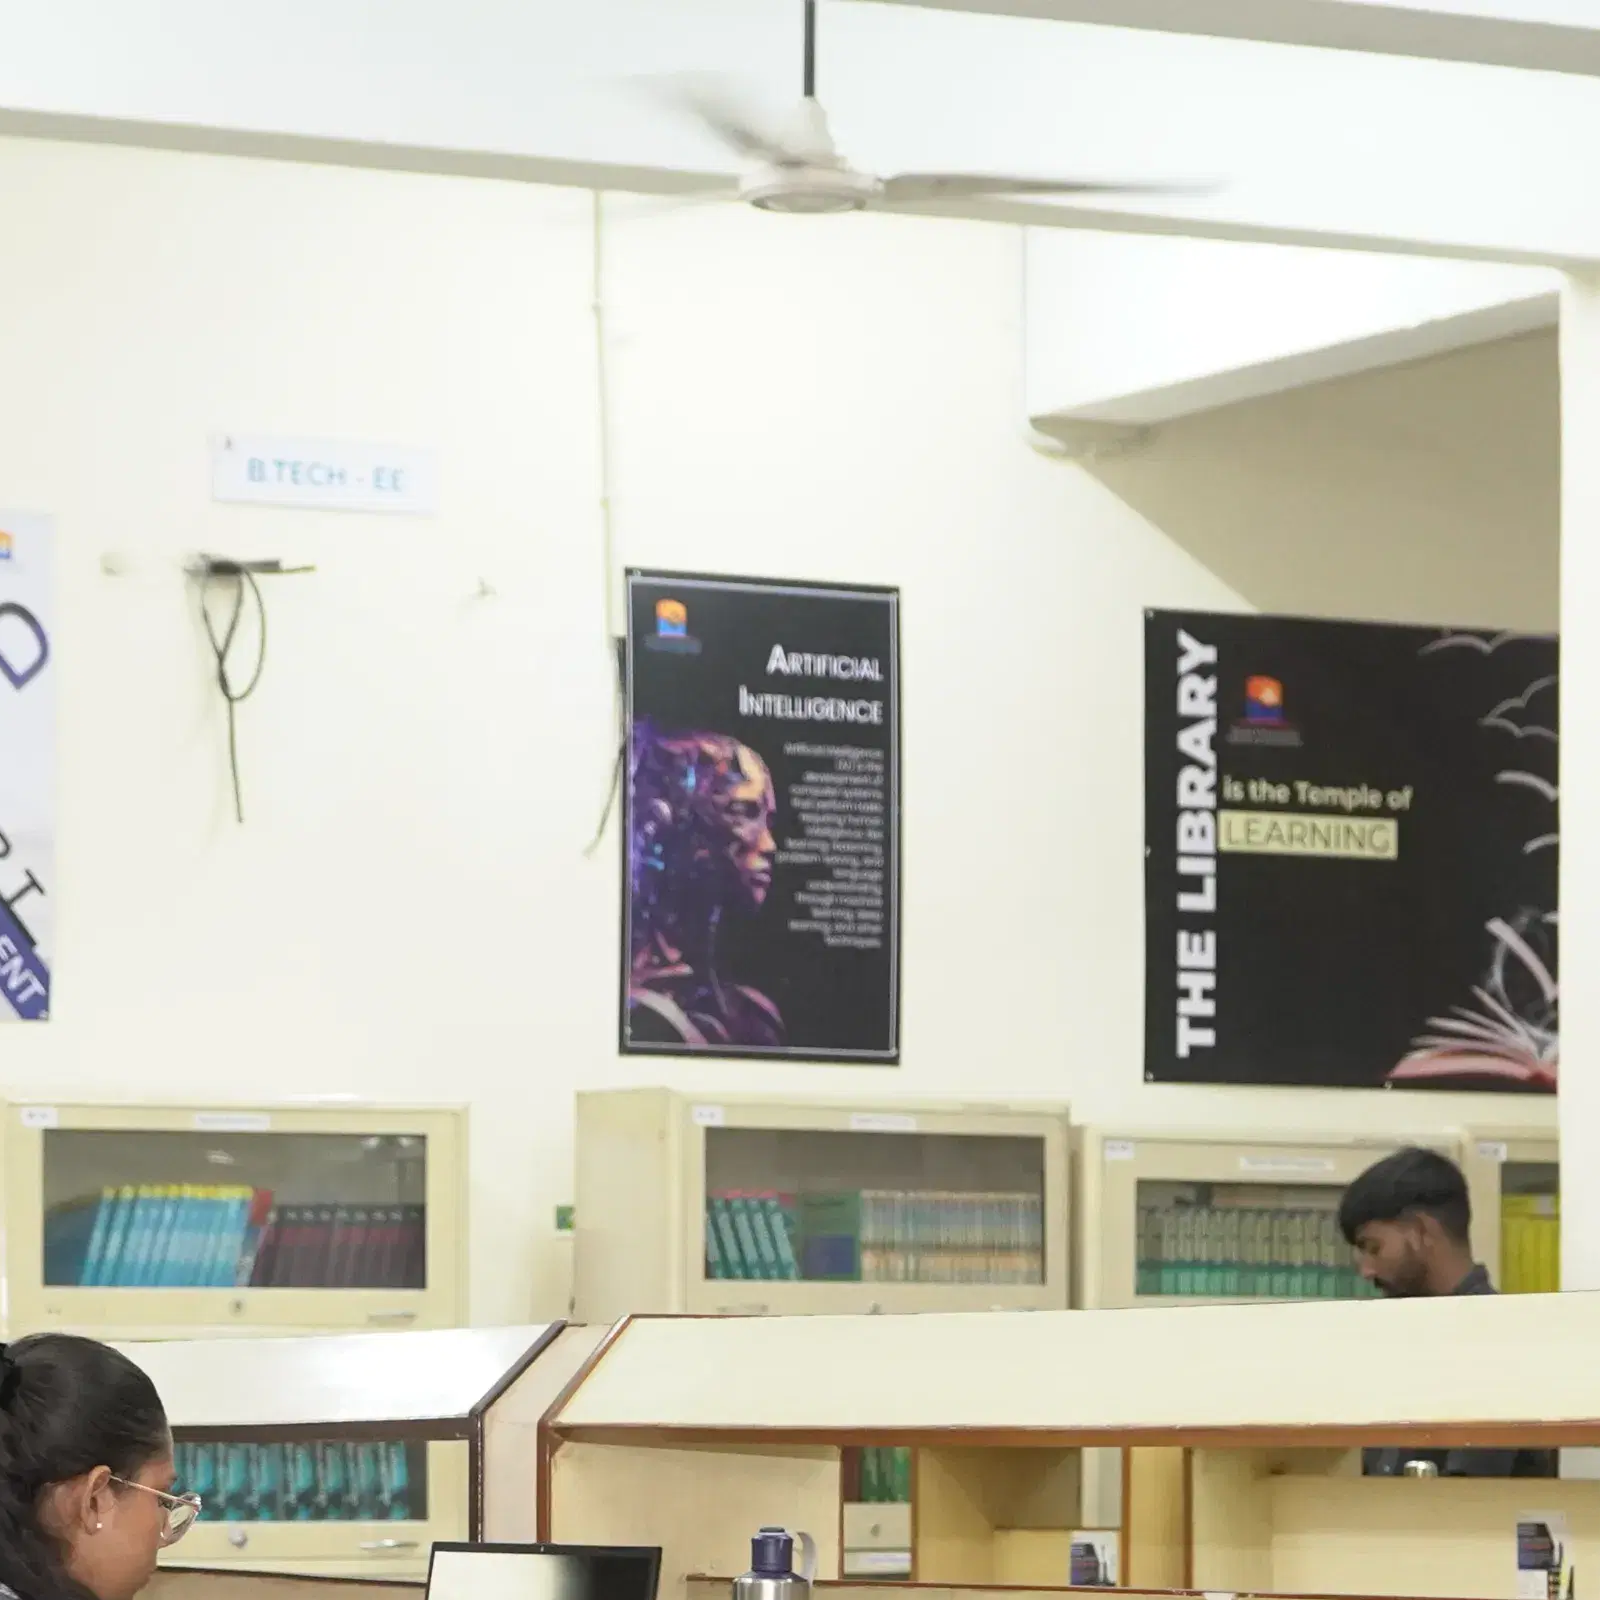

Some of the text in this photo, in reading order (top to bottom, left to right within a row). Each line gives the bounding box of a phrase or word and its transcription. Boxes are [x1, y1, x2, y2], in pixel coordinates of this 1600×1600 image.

[1248, 777, 1290, 804] the
[1293, 779, 1383, 812] Temple
[1385, 784, 1414, 811] of
[1176, 629, 1218, 1058] THE LIBRARY
[1224, 818, 1390, 853] LEARNING
